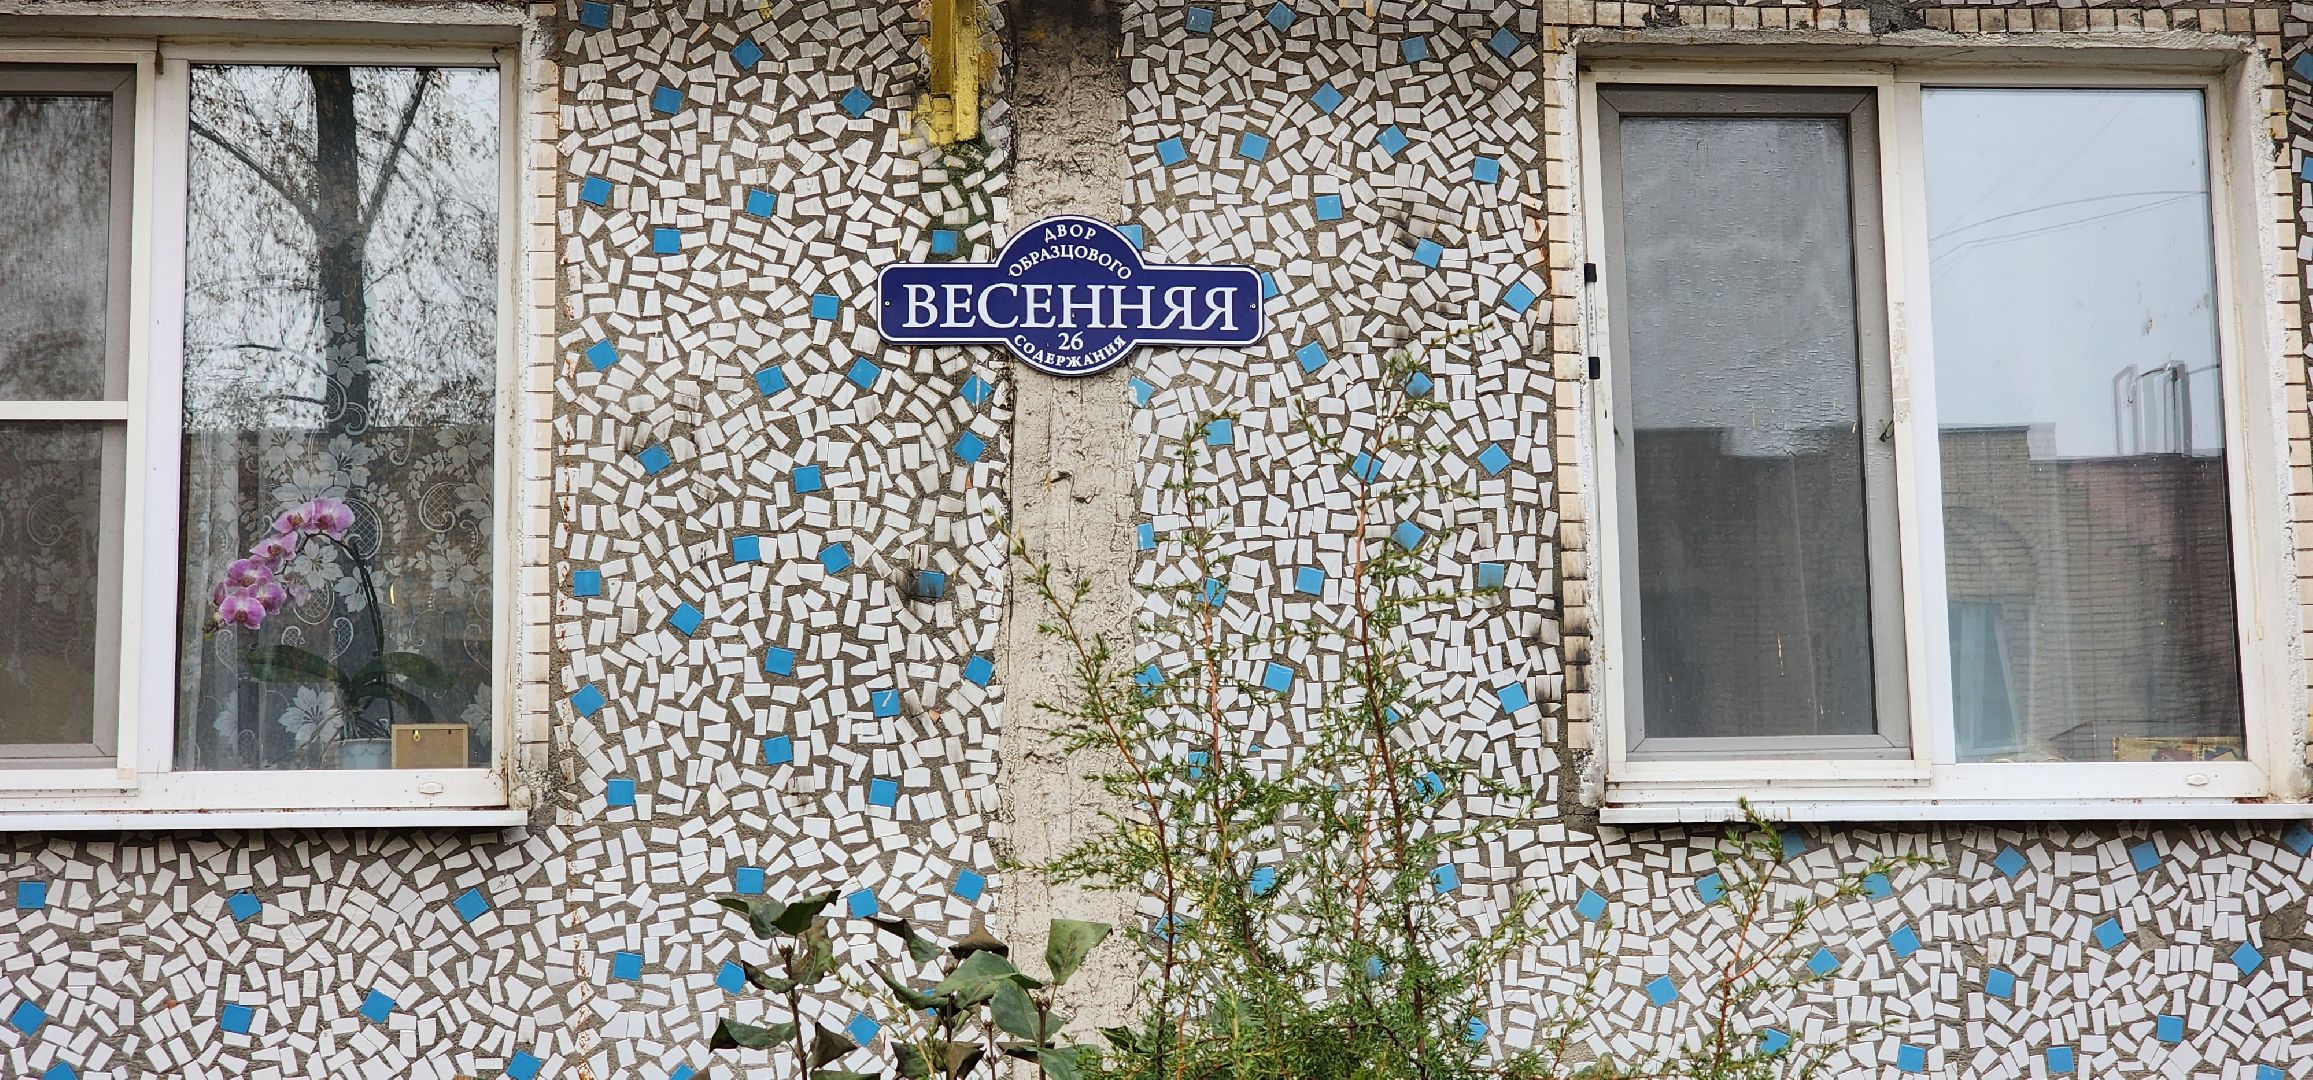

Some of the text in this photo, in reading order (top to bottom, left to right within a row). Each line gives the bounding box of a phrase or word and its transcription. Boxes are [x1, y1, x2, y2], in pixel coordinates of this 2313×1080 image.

[1044, 223, 1097, 243] ДВОР
[1008, 244, 1132, 280] ОБРАЗЦОВОГО
[901, 282, 1239, 331] ВЕСЕННЯЯ
[1013, 334, 1127, 368] СОДЕРЖАНИЯ
[1057, 331, 1085, 351] 26
